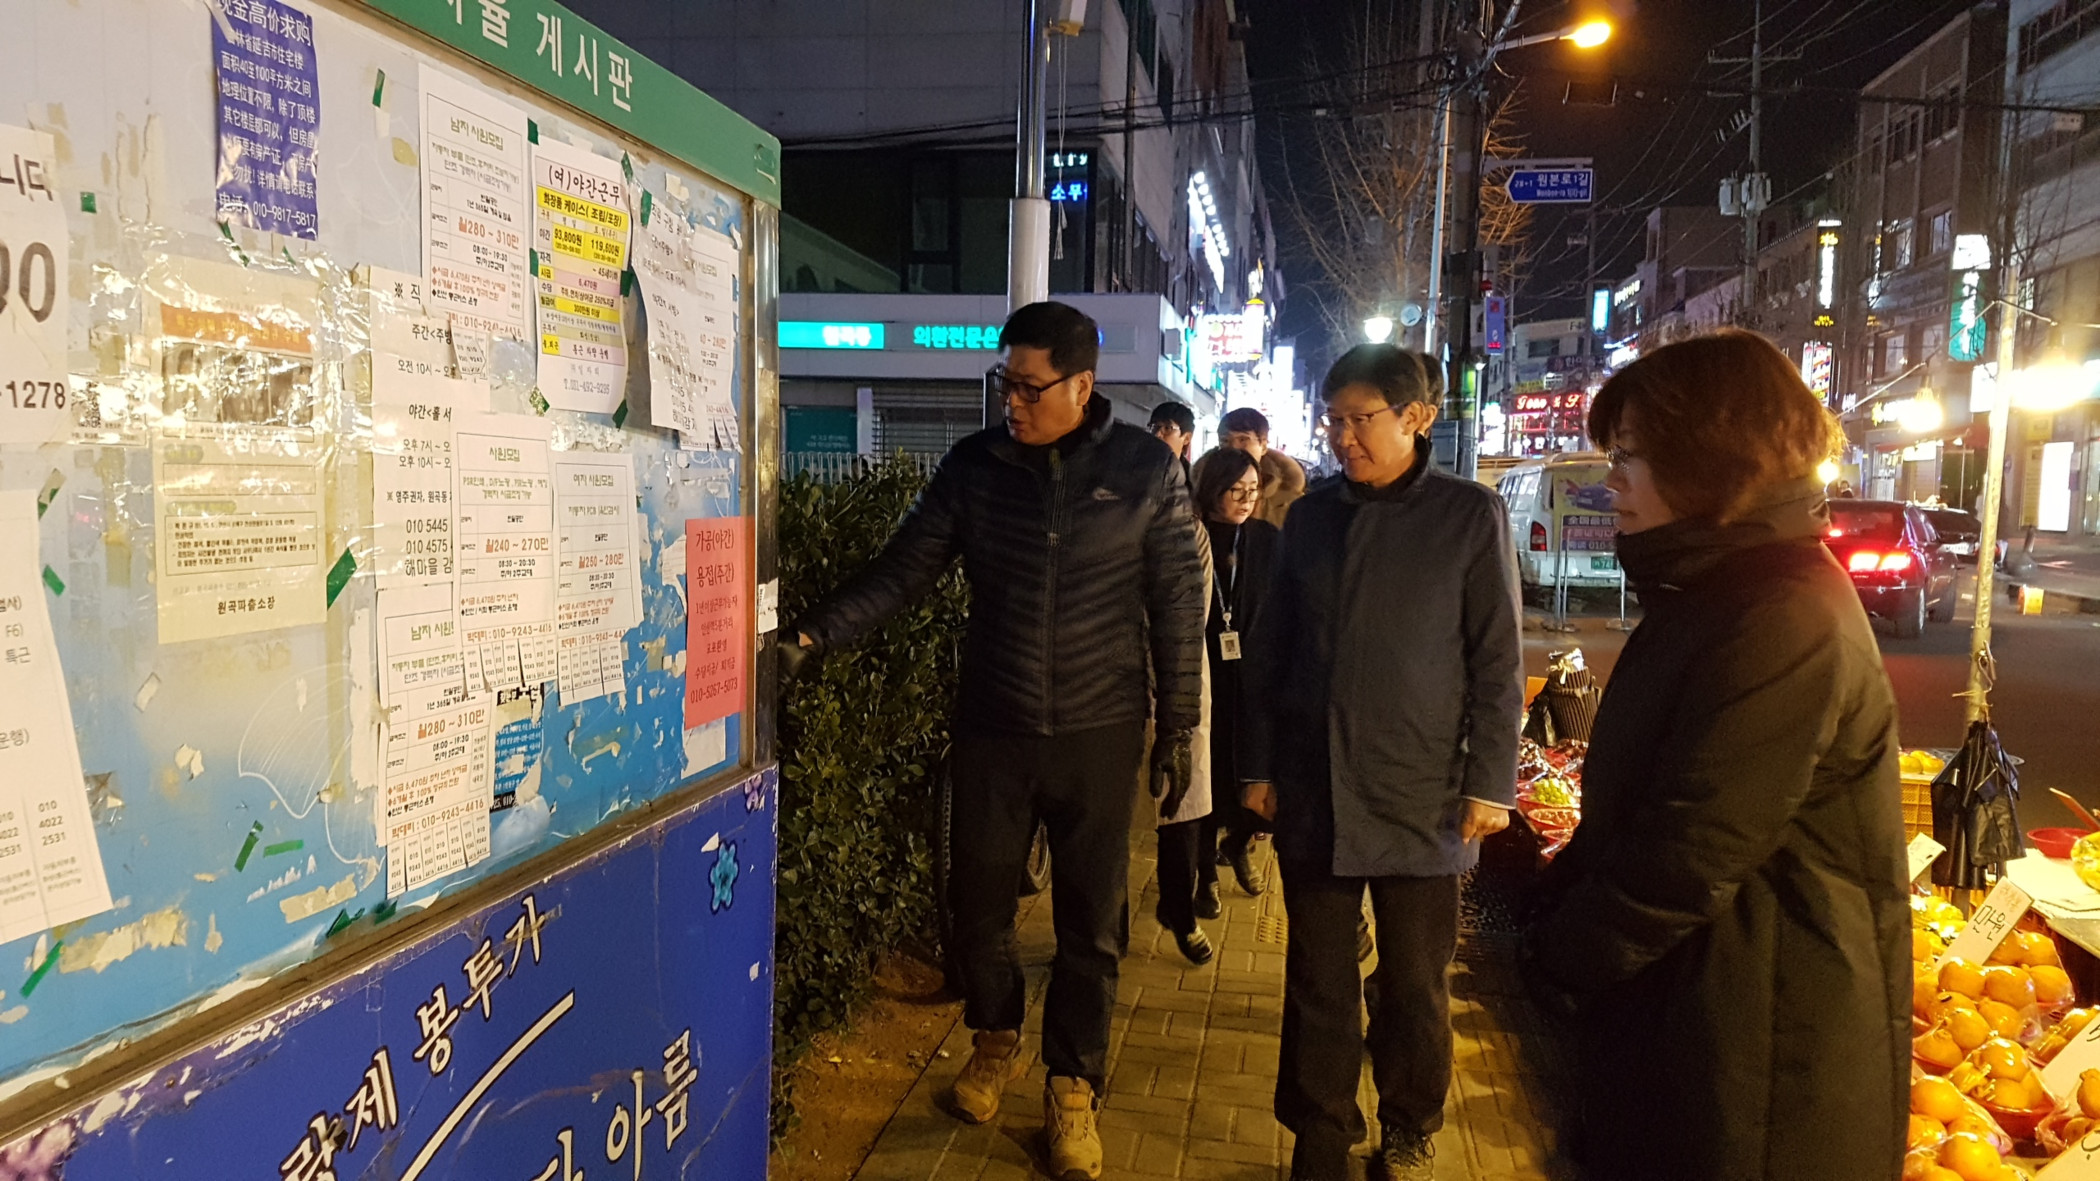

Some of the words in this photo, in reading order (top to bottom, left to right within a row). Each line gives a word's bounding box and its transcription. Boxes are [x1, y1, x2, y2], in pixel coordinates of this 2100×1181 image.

[536, 12, 633, 112] 게시판
[548, 164, 621, 206] (여)야간근무
[253, 201, 316, 227] 010-9817-5817
[398, 359, 414, 373] 오전
[416, 363, 433, 375] 10시
[420, 439, 433, 452] 7시
[399, 456, 415, 469] 오후
[417, 456, 434, 469] 10시
[406, 519, 424, 534] 010
[426, 519, 448, 533] 5445
[406, 539, 424, 555] 010
[426, 538, 448, 553] 4575
[696, 529, 735, 552] 가공(야간)
[696, 562, 735, 588] 용접(주간)
[217, 596, 276, 615] 원곡파출소장
[38, 800, 57, 812] 010
[421, 799, 484, 829] 010-9243-4416
[39, 815, 63, 828] 4022
[42, 831, 66, 846] 2531
[413, 893, 547, 1076] 봉투가
